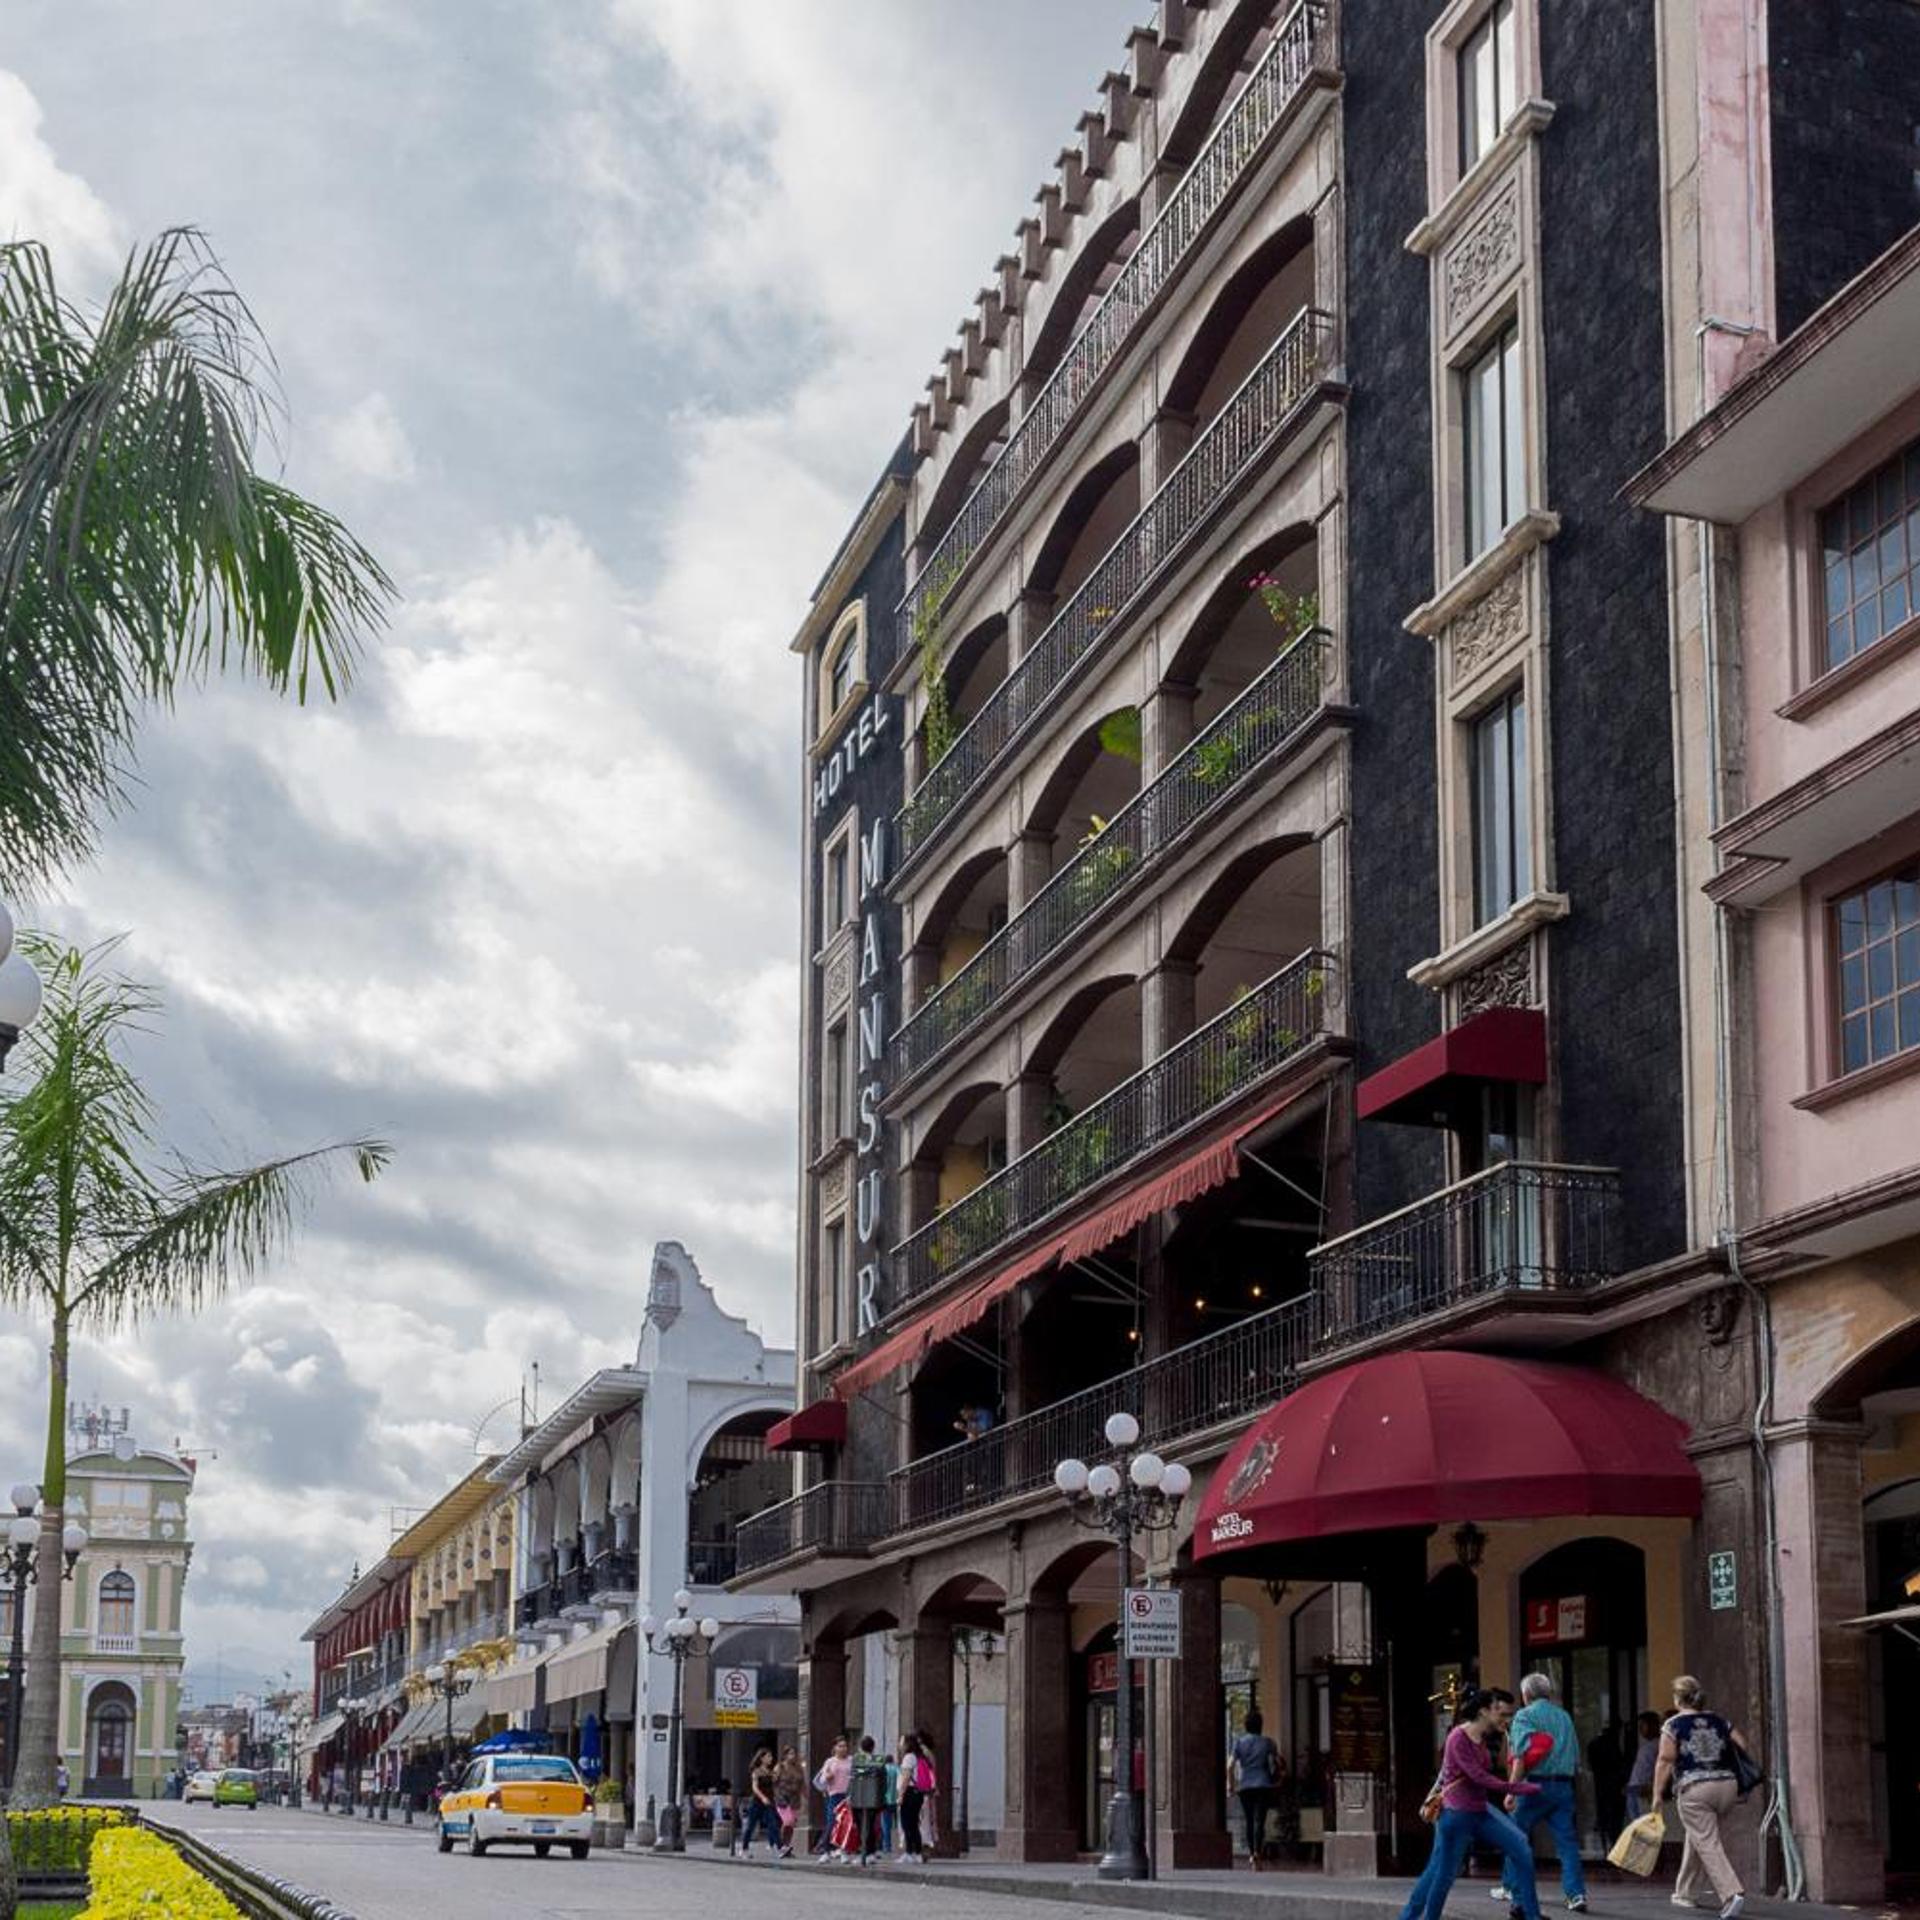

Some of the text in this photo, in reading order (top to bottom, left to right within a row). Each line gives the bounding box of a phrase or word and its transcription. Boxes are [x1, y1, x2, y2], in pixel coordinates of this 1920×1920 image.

[814, 693, 889, 818] HOTEL
[858, 817, 884, 1338] MANSUR
[1211, 1520, 1254, 1542] MANSUR
[1217, 1512, 1242, 1525] HOTEL
